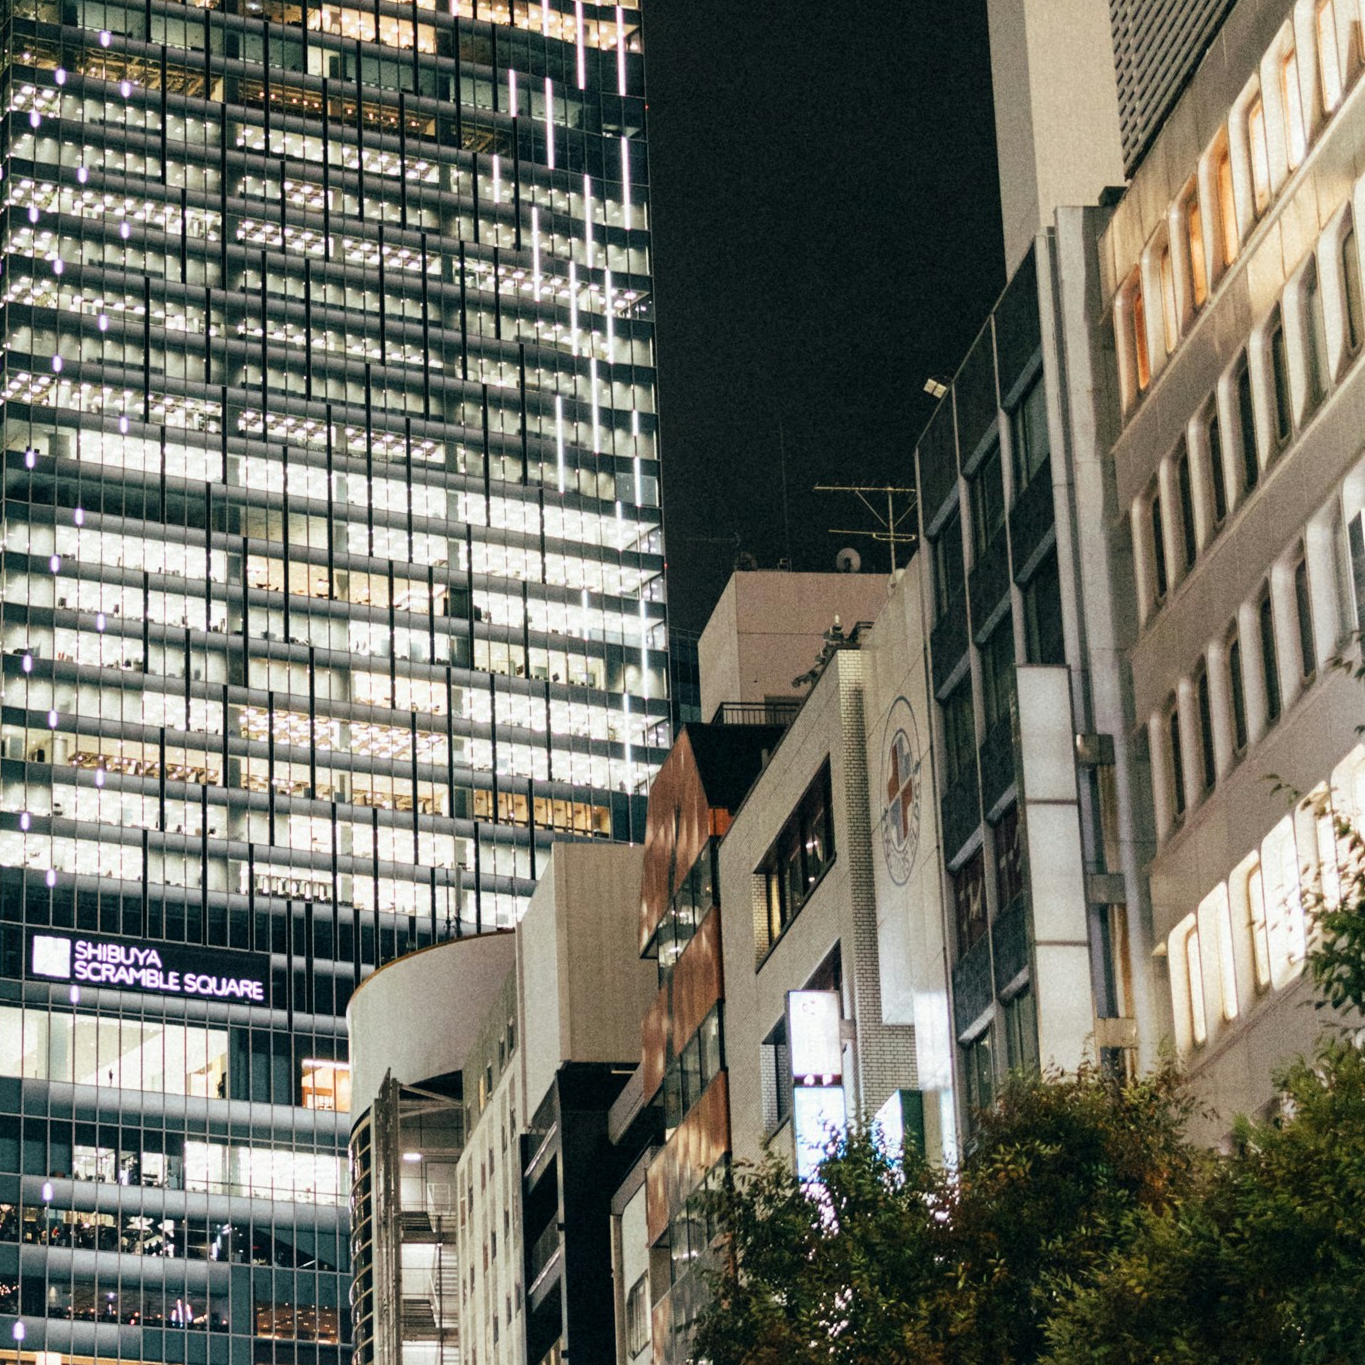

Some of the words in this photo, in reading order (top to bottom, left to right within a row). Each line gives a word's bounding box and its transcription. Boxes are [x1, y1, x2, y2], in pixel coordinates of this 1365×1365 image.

[74, 939, 162, 968] SHIBUYA
[74, 961, 181, 992] SCRAMBLE
[184, 973, 264, 1001] SQUARE
